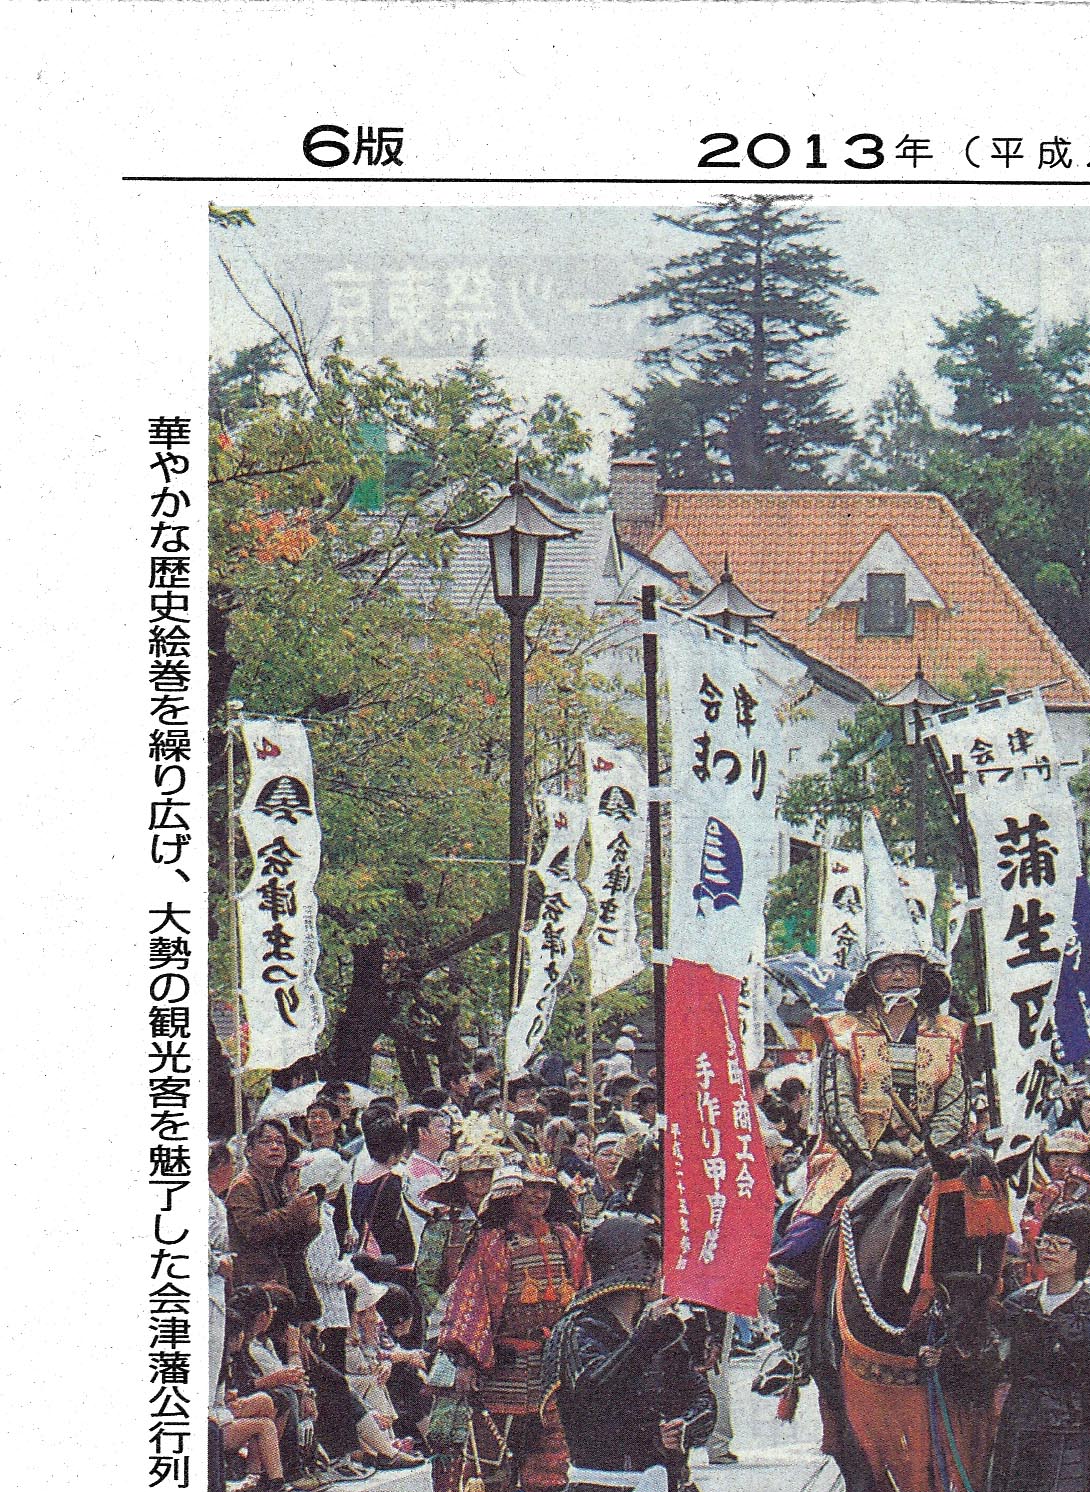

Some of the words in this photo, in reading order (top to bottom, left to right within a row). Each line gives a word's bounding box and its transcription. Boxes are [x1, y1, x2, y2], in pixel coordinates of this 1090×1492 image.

[303, 125, 403, 167] 6版
[692, 731, 767, 801] まつり
[148, 416, 191, 1488] 華やかな歴史絵巻を繰り広げ、大勢の観光客を魅了した会津藩公行列
